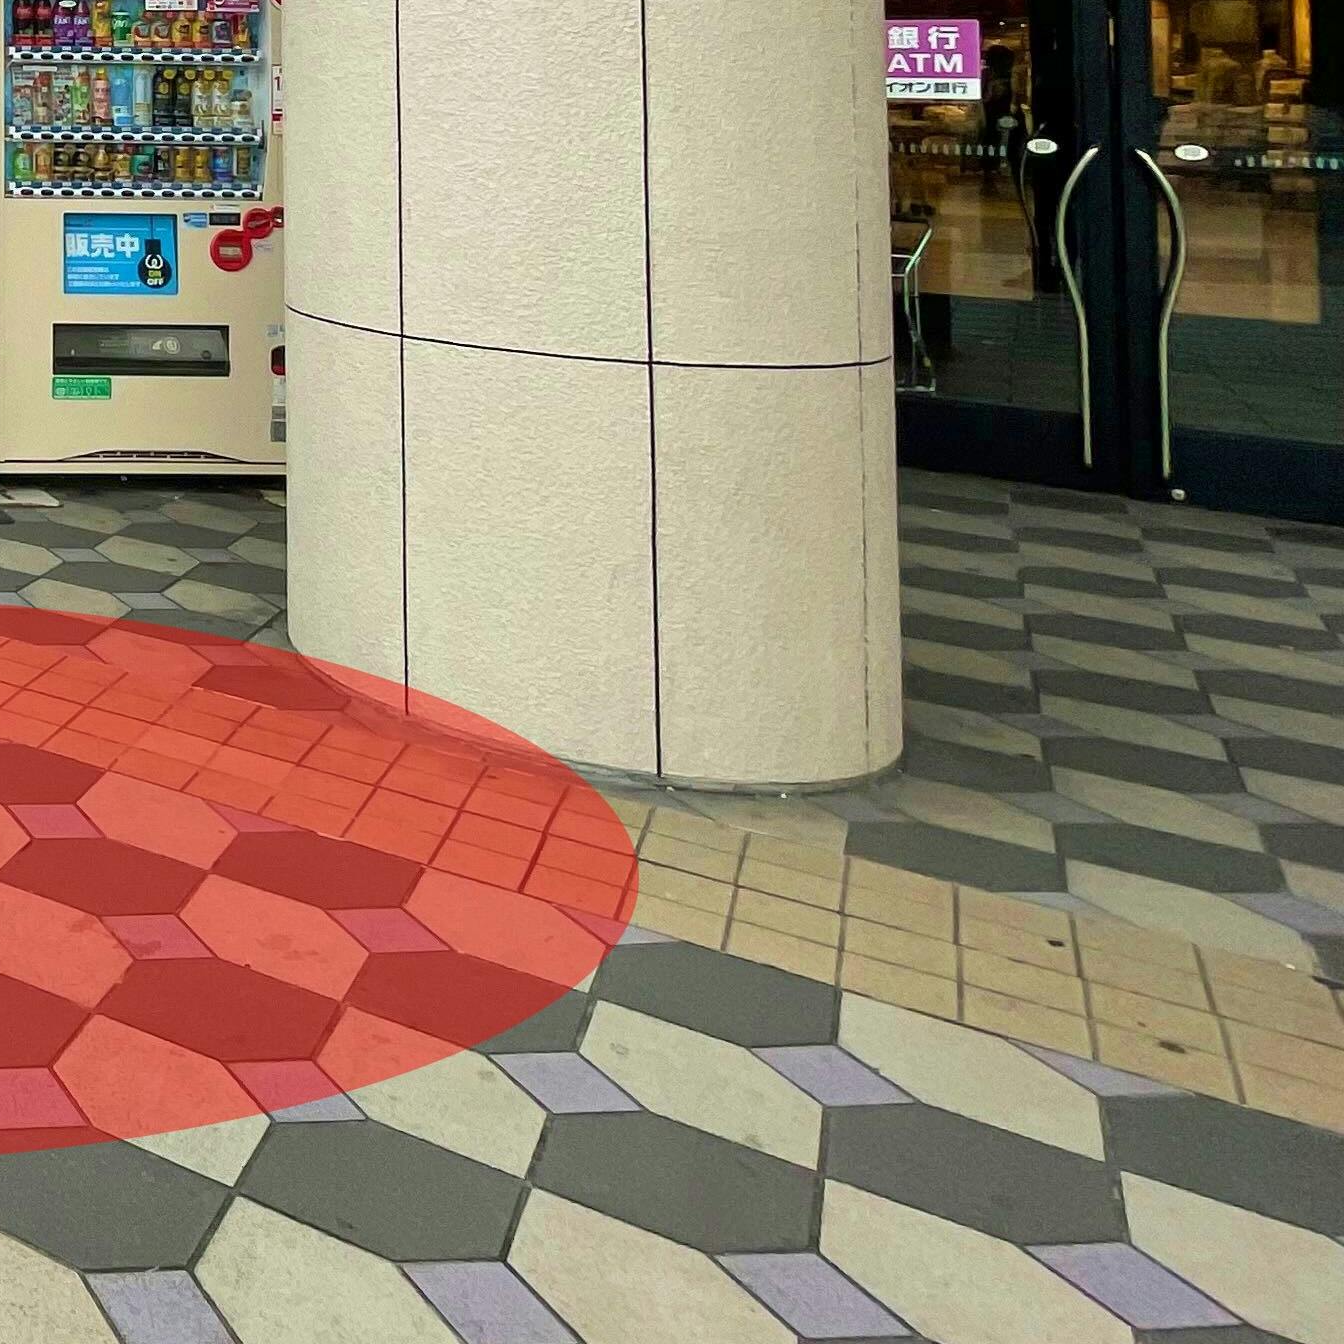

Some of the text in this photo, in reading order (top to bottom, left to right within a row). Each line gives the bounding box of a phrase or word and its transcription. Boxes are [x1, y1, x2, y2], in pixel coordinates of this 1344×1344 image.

[887, 26, 960, 50] 銀行
[887, 53, 964, 73] ATM
[887, 82, 968, 94] イオン銀行
[65, 232, 140, 258] 販売中
